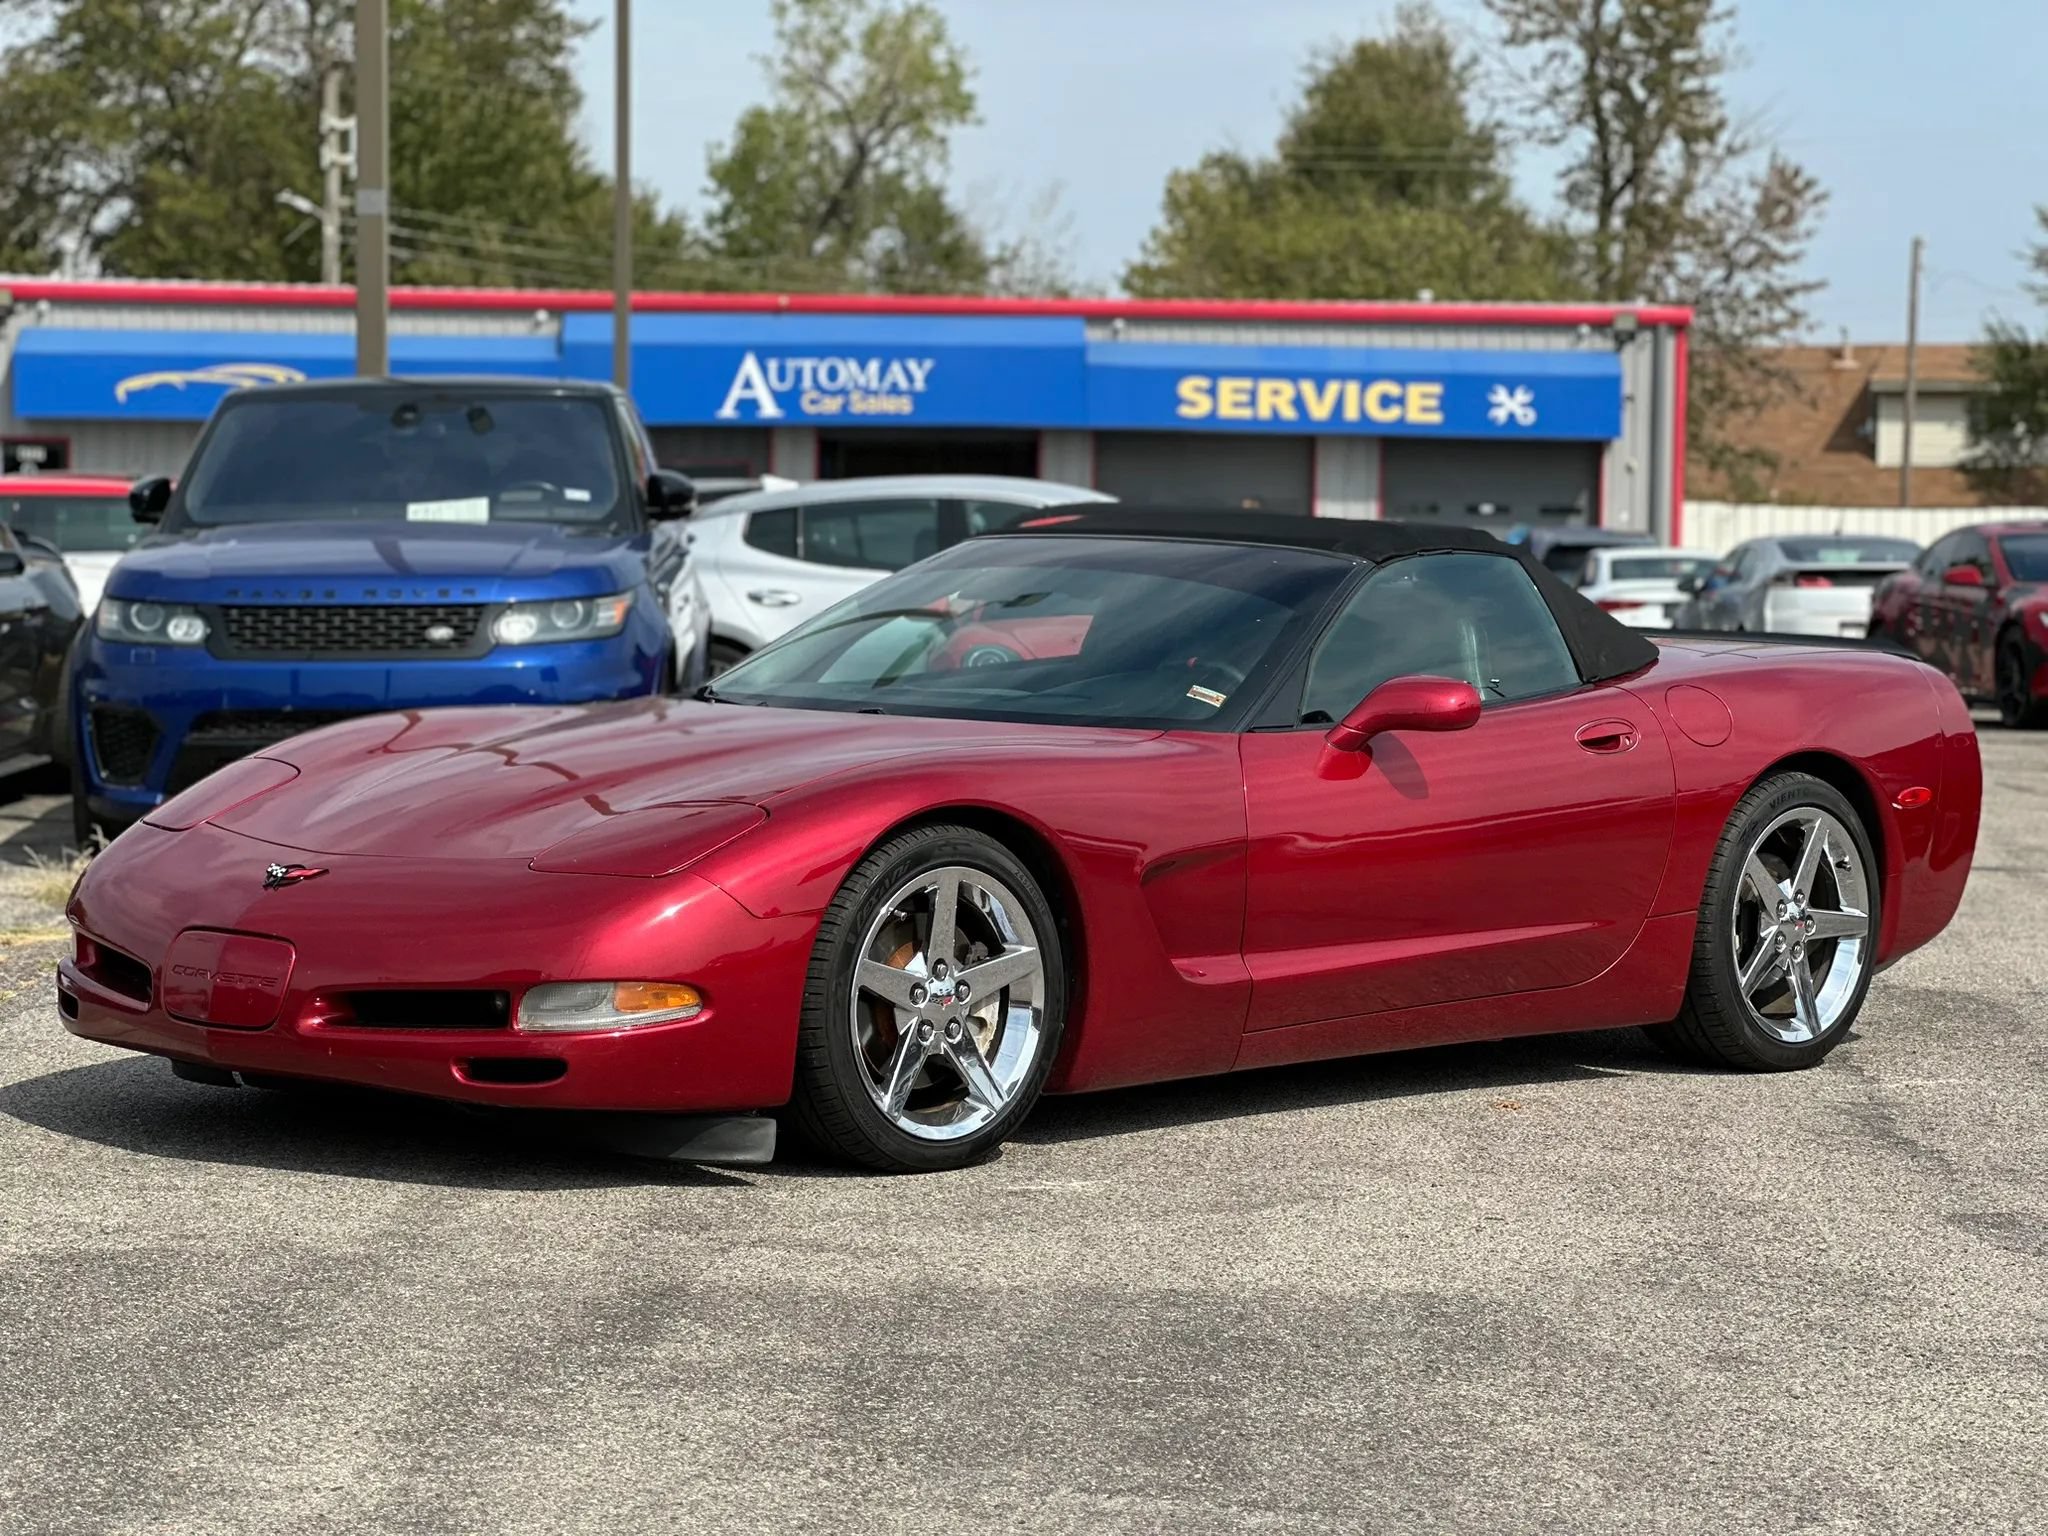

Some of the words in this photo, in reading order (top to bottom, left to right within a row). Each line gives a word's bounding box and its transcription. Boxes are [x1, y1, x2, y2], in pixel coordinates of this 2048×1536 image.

[715, 350, 935, 419] AUTOMAY
[800, 389, 843, 416] Car
[847, 388, 914, 416] Sales
[1176, 375, 1444, 424] SERVICE
[227, 588, 336, 599] RANGE
[362, 588, 477, 598] ROVER
[172, 964, 278, 987] CORVETTE
